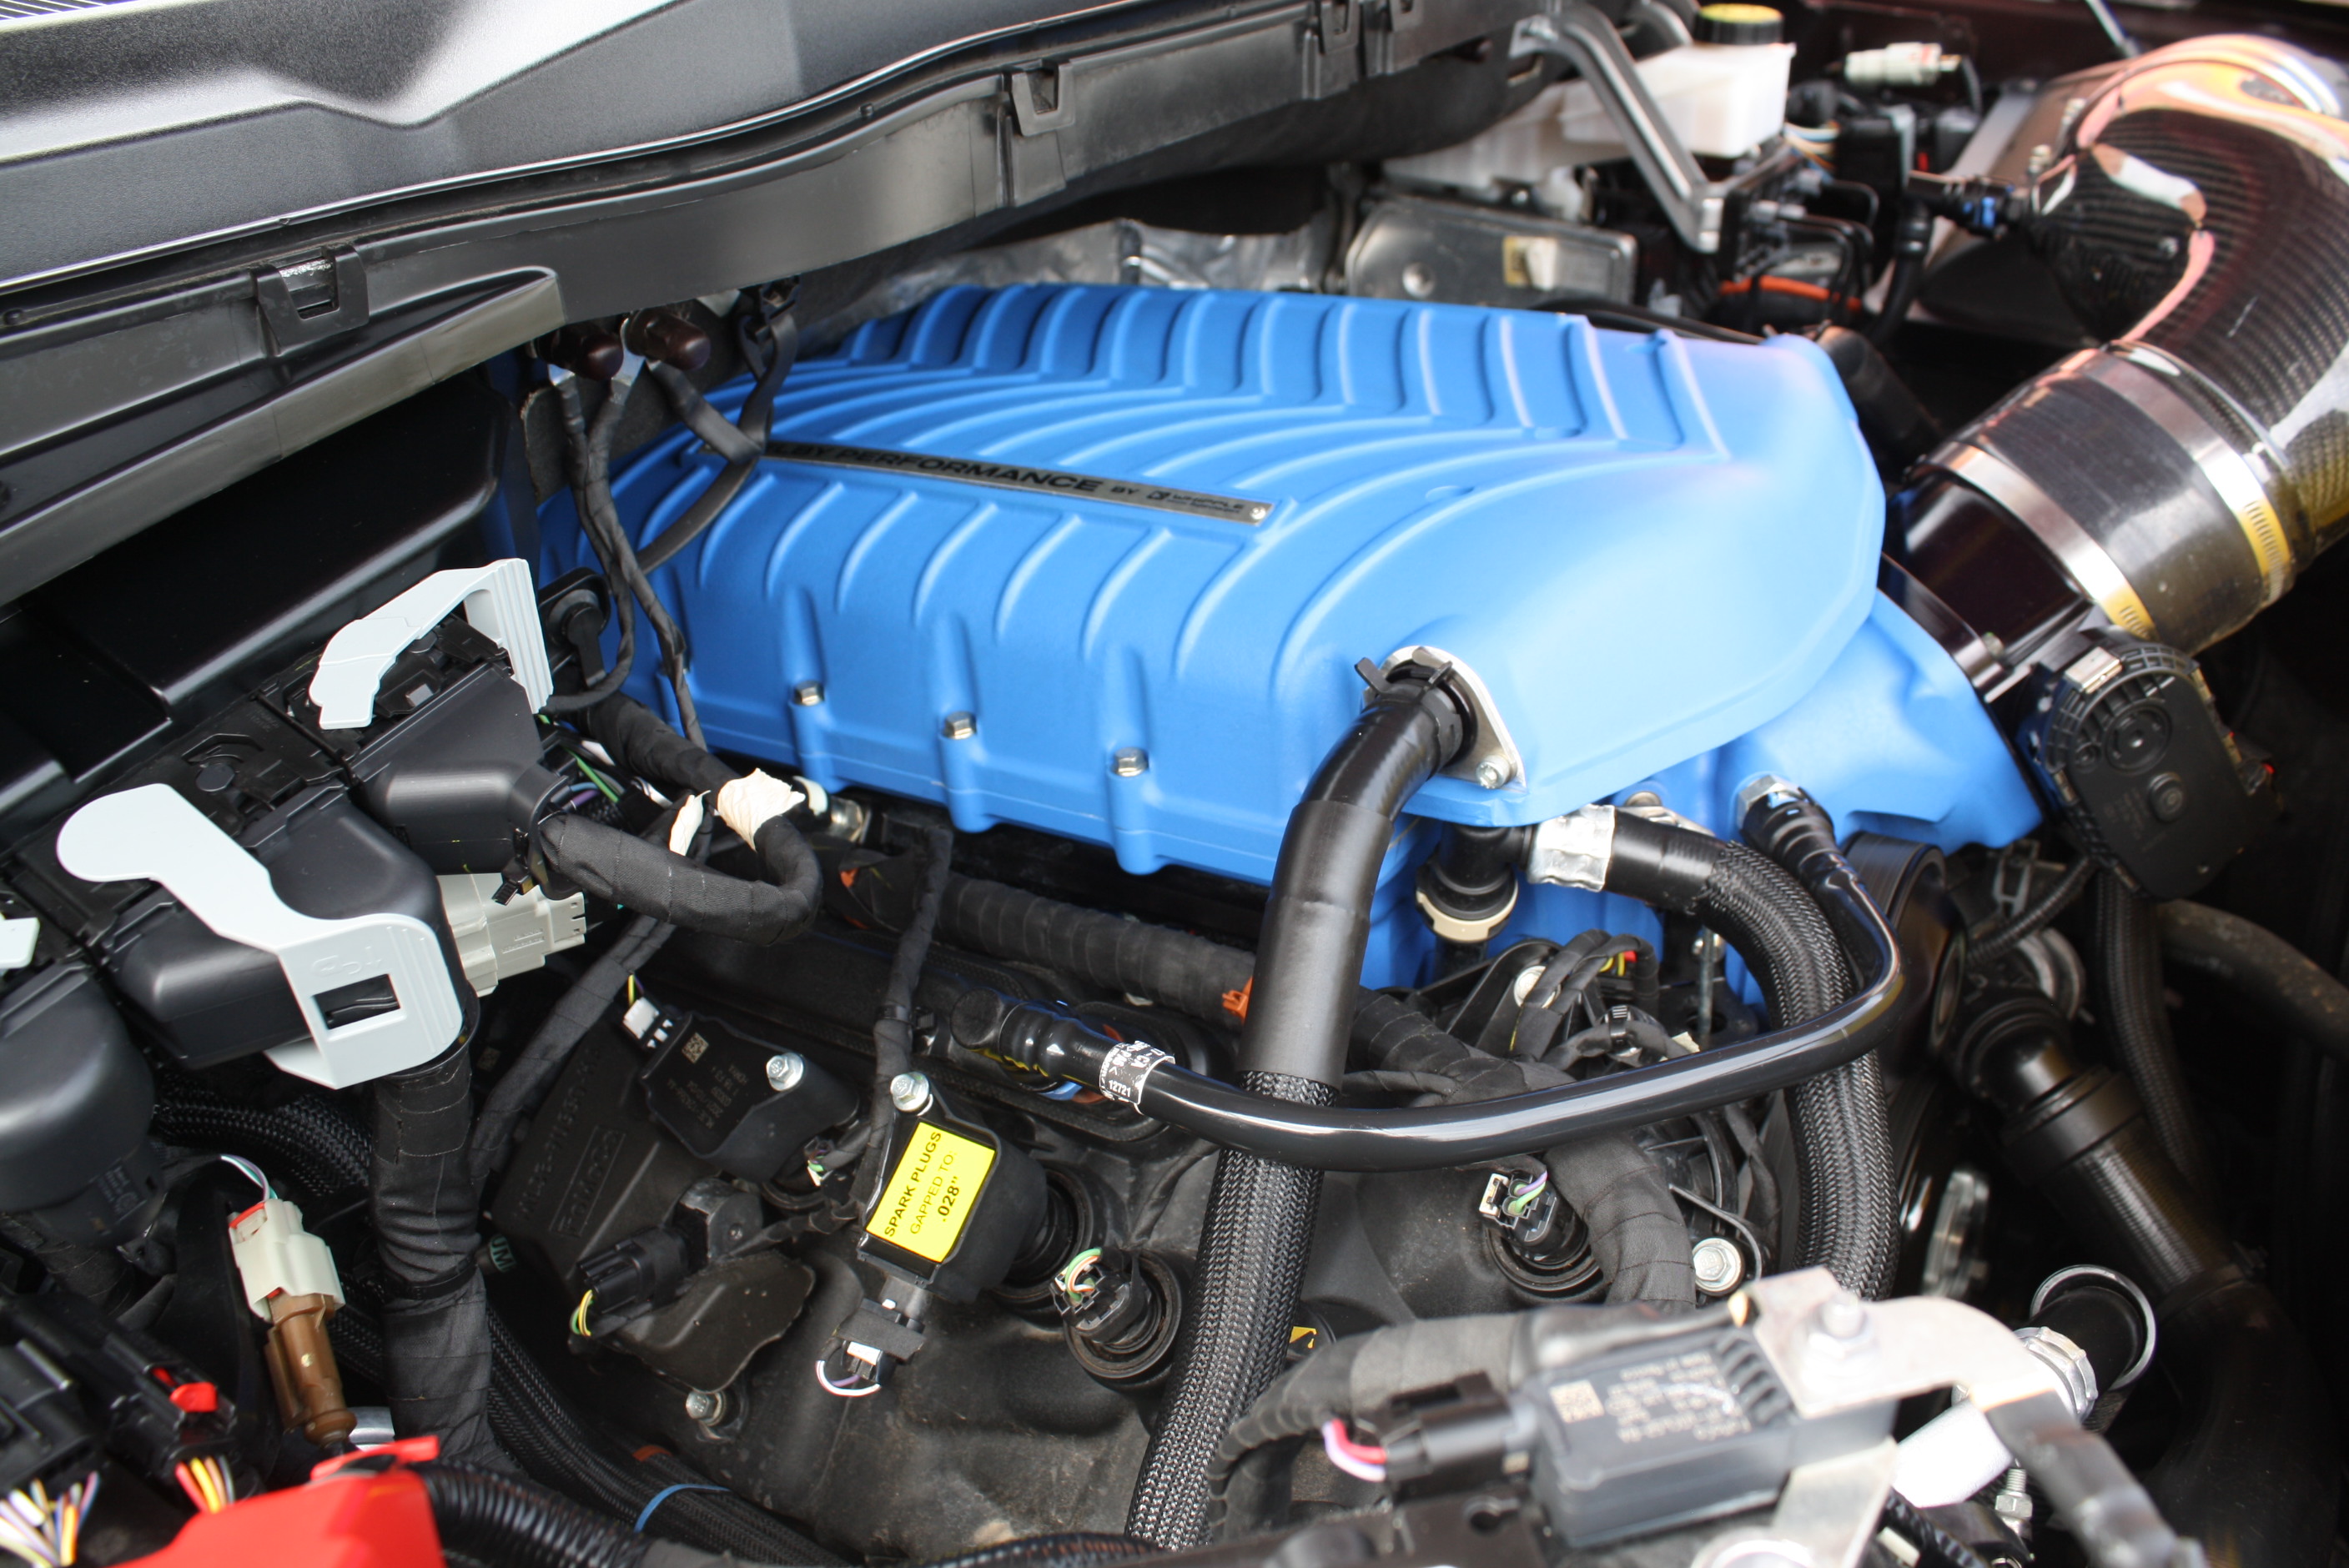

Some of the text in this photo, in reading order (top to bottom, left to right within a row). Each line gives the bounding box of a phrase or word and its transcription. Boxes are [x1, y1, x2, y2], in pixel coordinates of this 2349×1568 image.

[836, 450, 1104, 492] PERFORMANCE
[1110, 485, 1139, 495] BY
[1109, 1080, 1131, 1098] 12721
[884, 1132, 942, 1237] SPARK PLUGS
[910, 1176, 943, 1234] GAPPED
